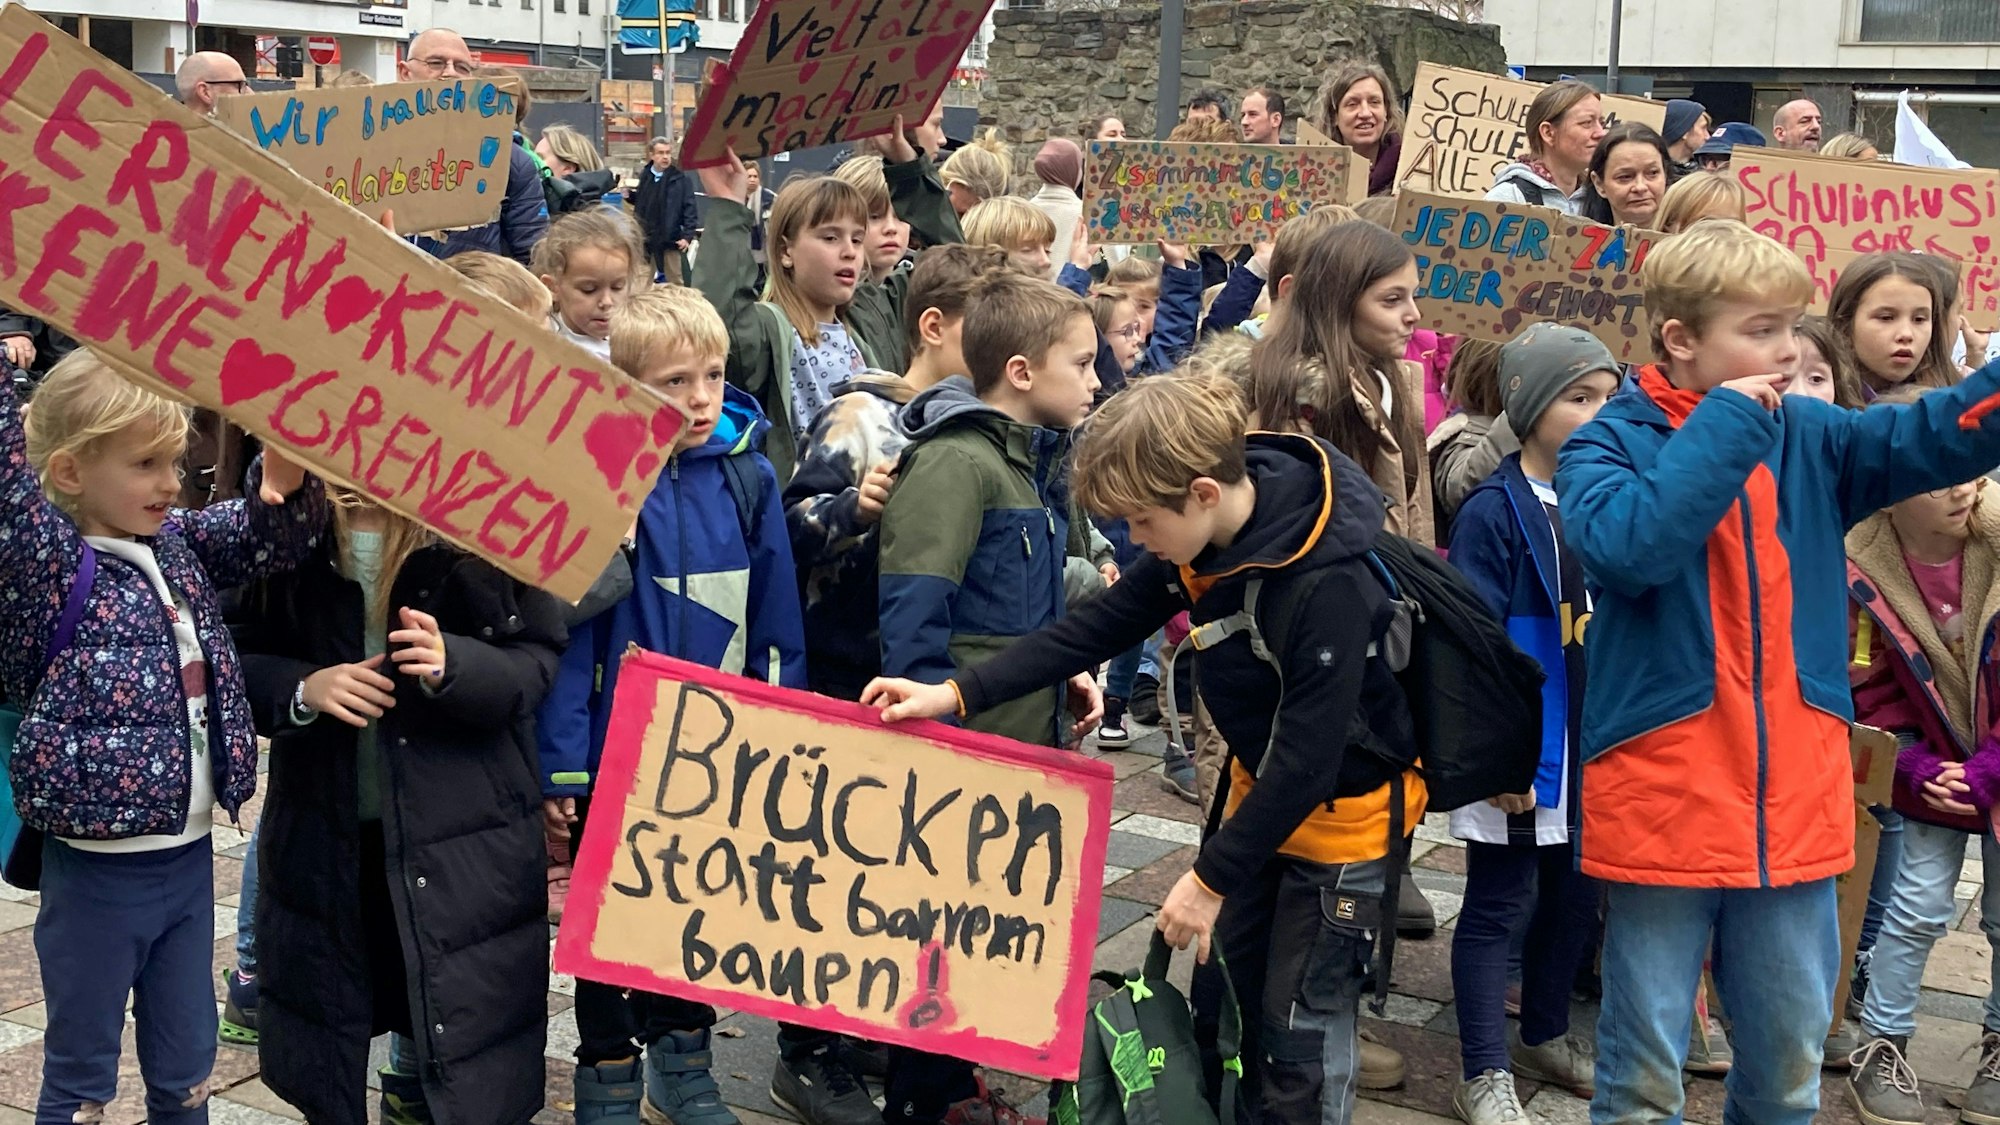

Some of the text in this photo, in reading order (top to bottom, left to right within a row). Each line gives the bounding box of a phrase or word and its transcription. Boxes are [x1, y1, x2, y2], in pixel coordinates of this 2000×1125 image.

[250, 97, 339, 151] Wir
[1402, 206, 1550, 261] JEDER
[1416, 255, 1644, 326] EDER GEHÖRT
[361, 273, 605, 445] KENNT
[267, 369, 591, 584] GRENZEN
[654, 680, 1064, 907] Brücken
